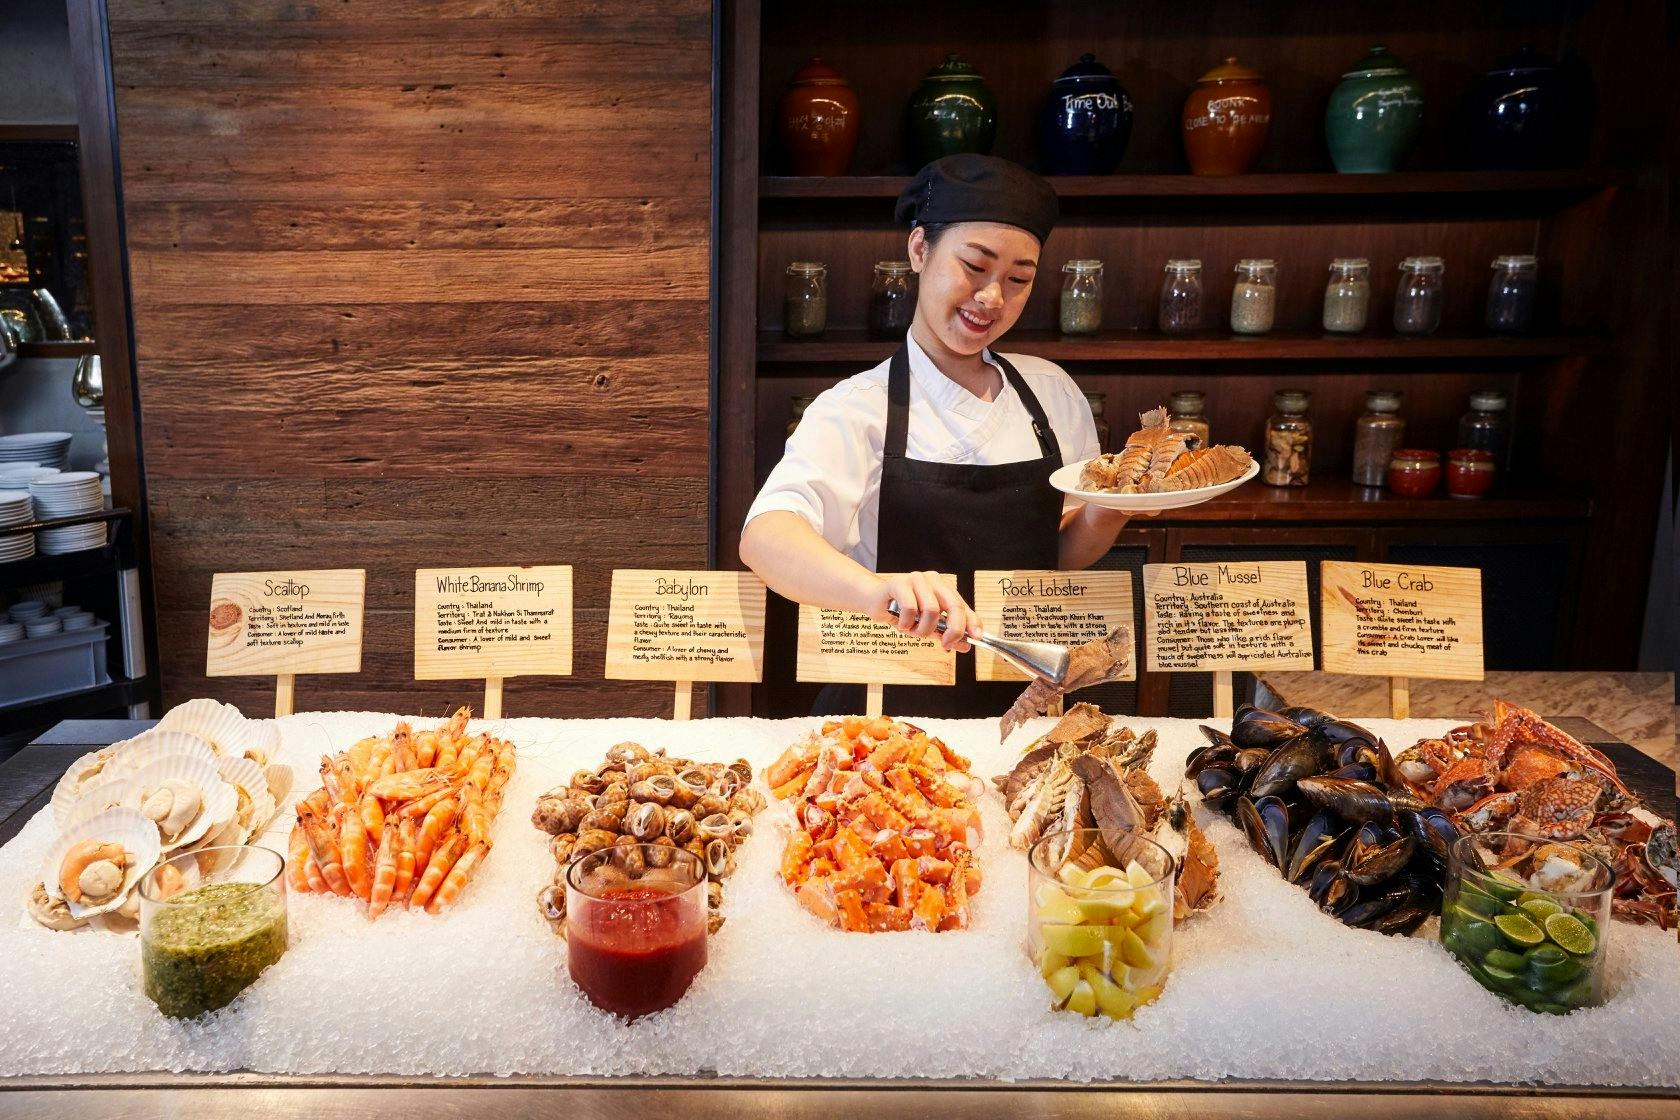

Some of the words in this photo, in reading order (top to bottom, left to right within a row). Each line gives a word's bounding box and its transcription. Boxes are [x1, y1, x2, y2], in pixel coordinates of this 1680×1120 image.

[1061, 94, 1093, 110] Time
[1172, 566, 1209, 587] Blue
[1218, 565, 1261, 585] Mussel
[437, 576, 468, 593] White
[470, 575, 506, 593] Banana
[508, 574, 544, 597] Shrimp
[1361, 570, 1390, 589] Blue
[1398, 572, 1433, 592] Crab
[264, 579, 309, 599] Scallop
[655, 577, 708, 601] Babylon
[998, 578, 1035, 597] Rock
[1040, 578, 1087, 597] Lobster
[1190, 593, 1223, 601] Australia
[438, 603, 460, 611] Country
[1194, 601, 1229, 609] Southern
[1262, 599, 1295, 608] Australia
[1356, 598, 1381, 608] Country
[1389, 599, 1417, 607] Thailand
[635, 605, 659, 613] Country
[1003, 606, 1027, 614] Country
[437, 612, 465, 621] Territory
[634, 613, 661, 621] Territory
[669, 613, 693, 622] Rayong
[1002, 614, 1031, 623] Territory
[478, 626, 483, 634] of
[1086, 623, 1107, 631] strong
[246, 639, 258, 647] soft
[283, 638, 303, 648] scallop
[695, 655, 714, 664] strong
